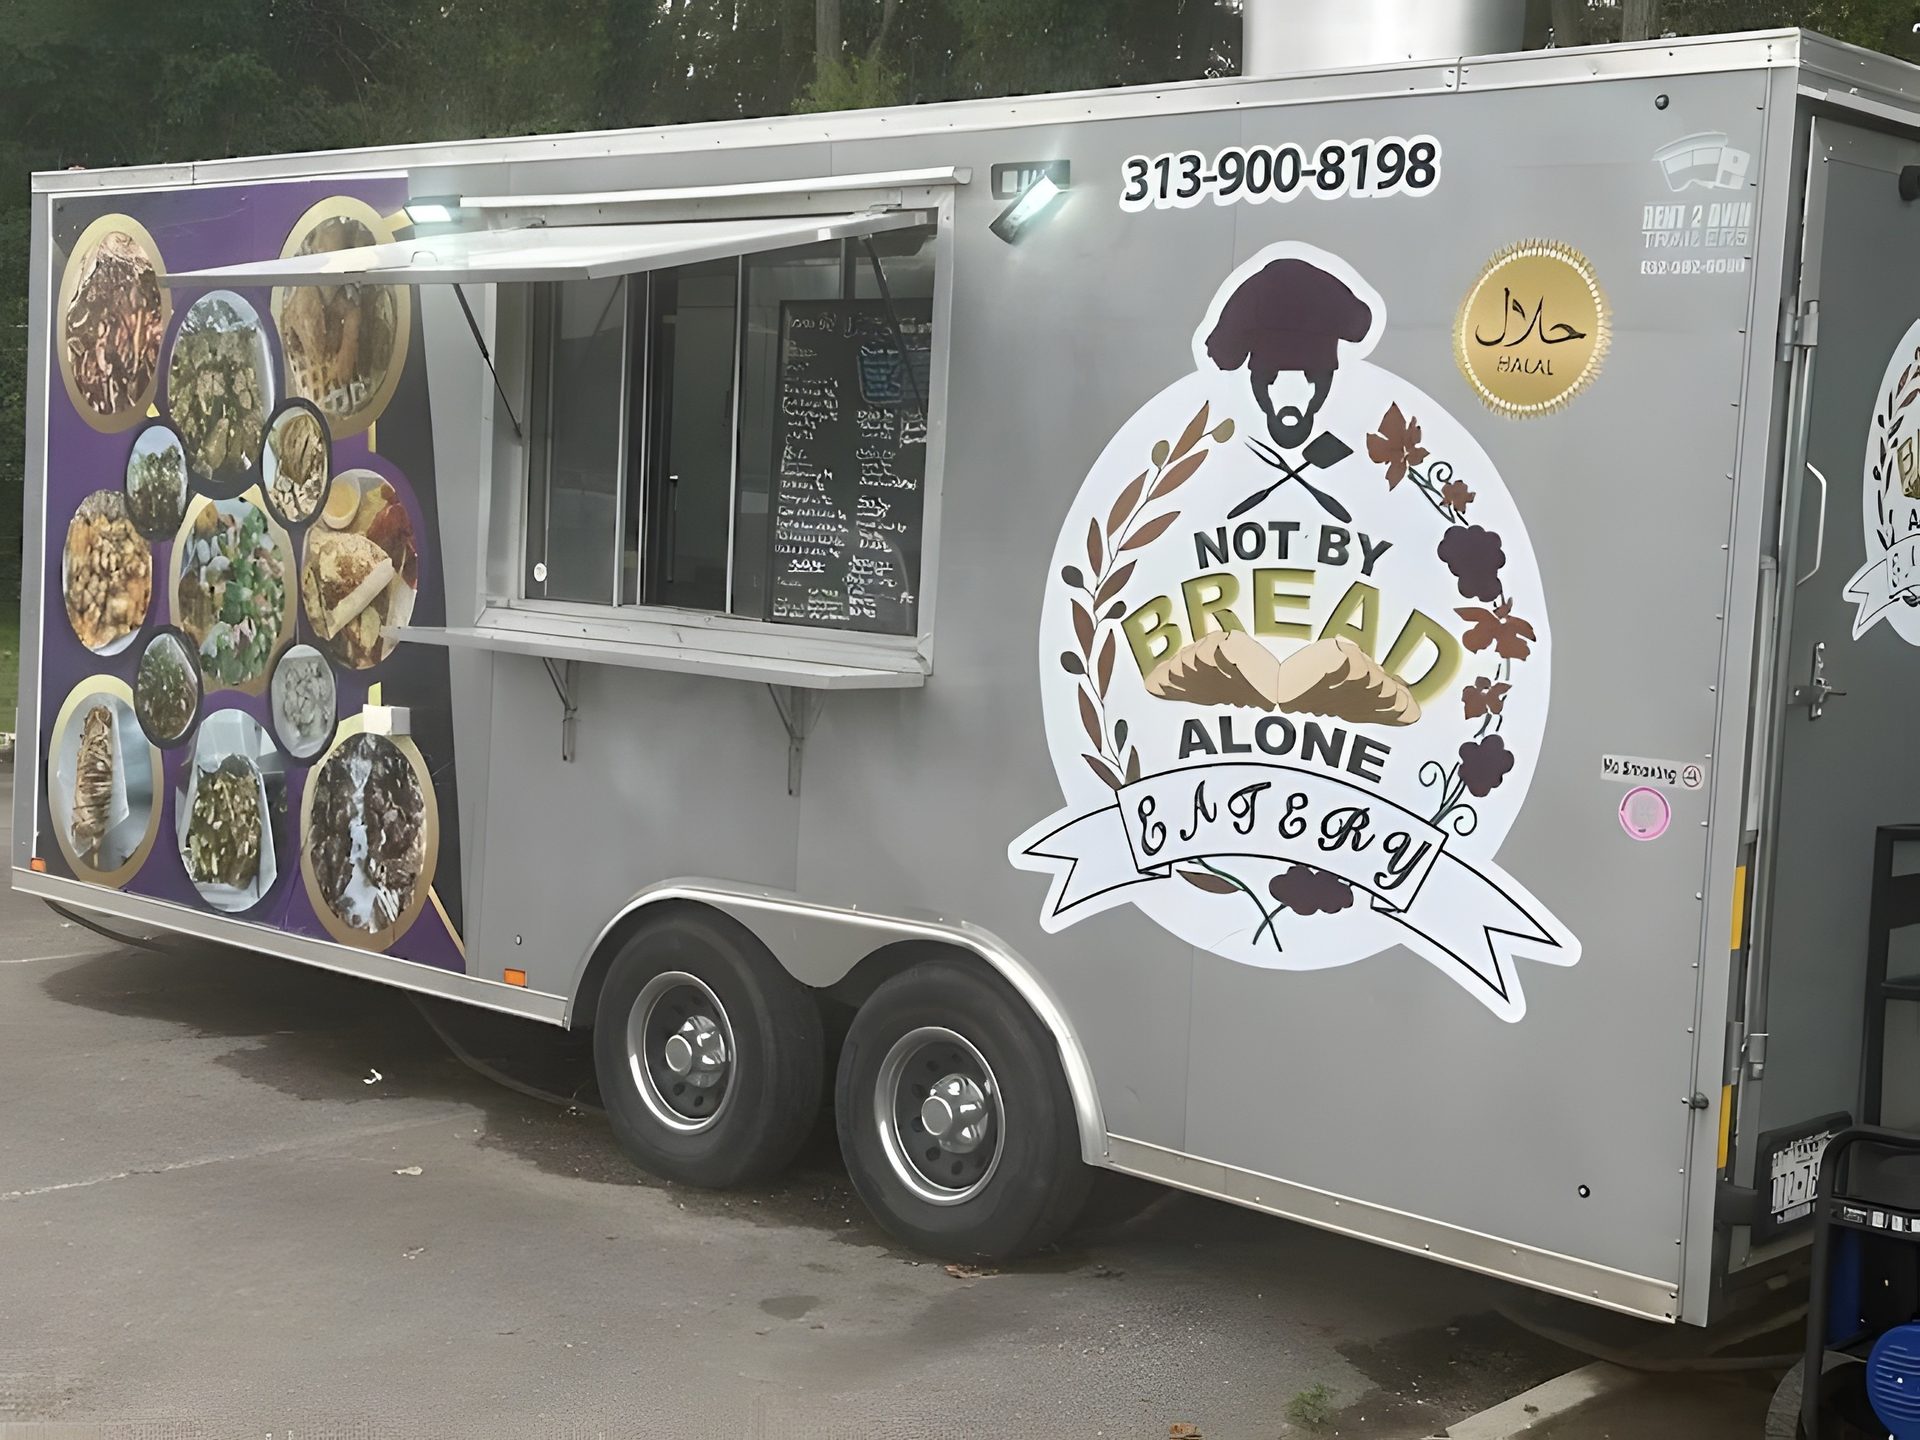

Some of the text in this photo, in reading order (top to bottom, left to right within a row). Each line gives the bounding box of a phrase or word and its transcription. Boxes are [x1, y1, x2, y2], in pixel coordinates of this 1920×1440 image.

[1124, 141, 1437, 202] 313-900-8198
[1474, 287, 1587, 348] حلال
[1497, 356, 1554, 376] HALAL
[1193, 521, 1393, 576] NOT BY
[1121, 567, 1464, 705] BREAD
[1178, 715, 1393, 784] ALONE
[1136, 779, 1432, 890] EATERY
